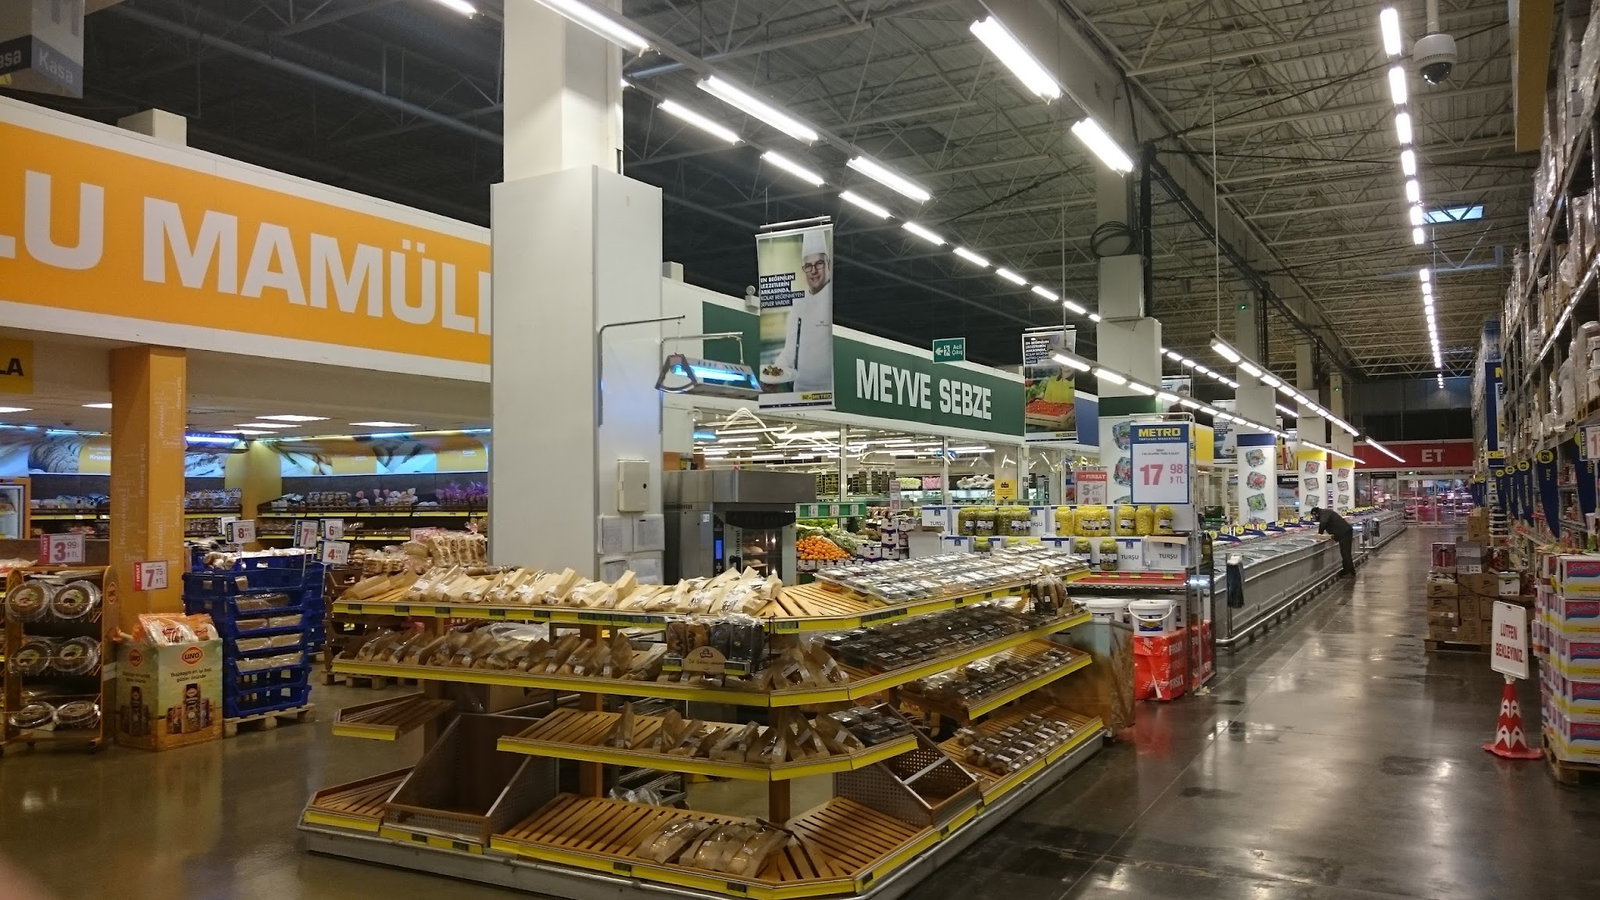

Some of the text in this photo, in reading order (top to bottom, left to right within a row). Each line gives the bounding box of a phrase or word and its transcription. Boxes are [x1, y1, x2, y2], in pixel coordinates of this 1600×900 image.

[40, 48, 73, 85] Kasa
[856, 358, 992, 420] MEYVE SEBZE
[1138, 428, 1181, 437] METRO
[1421, 449, 1443, 462] ET
[1140, 463, 1184, 486] 17 98
[237, 527, 245, 539] 8
[303, 528, 310, 546] 7
[328, 525, 335, 536] 6
[54, 541, 77, 561] 3 99
[327, 549, 335, 560] 4
[145, 569, 154, 587] 7
[1500, 621, 1517, 641] LÜTFEN
[184, 651, 200, 660] UNO
